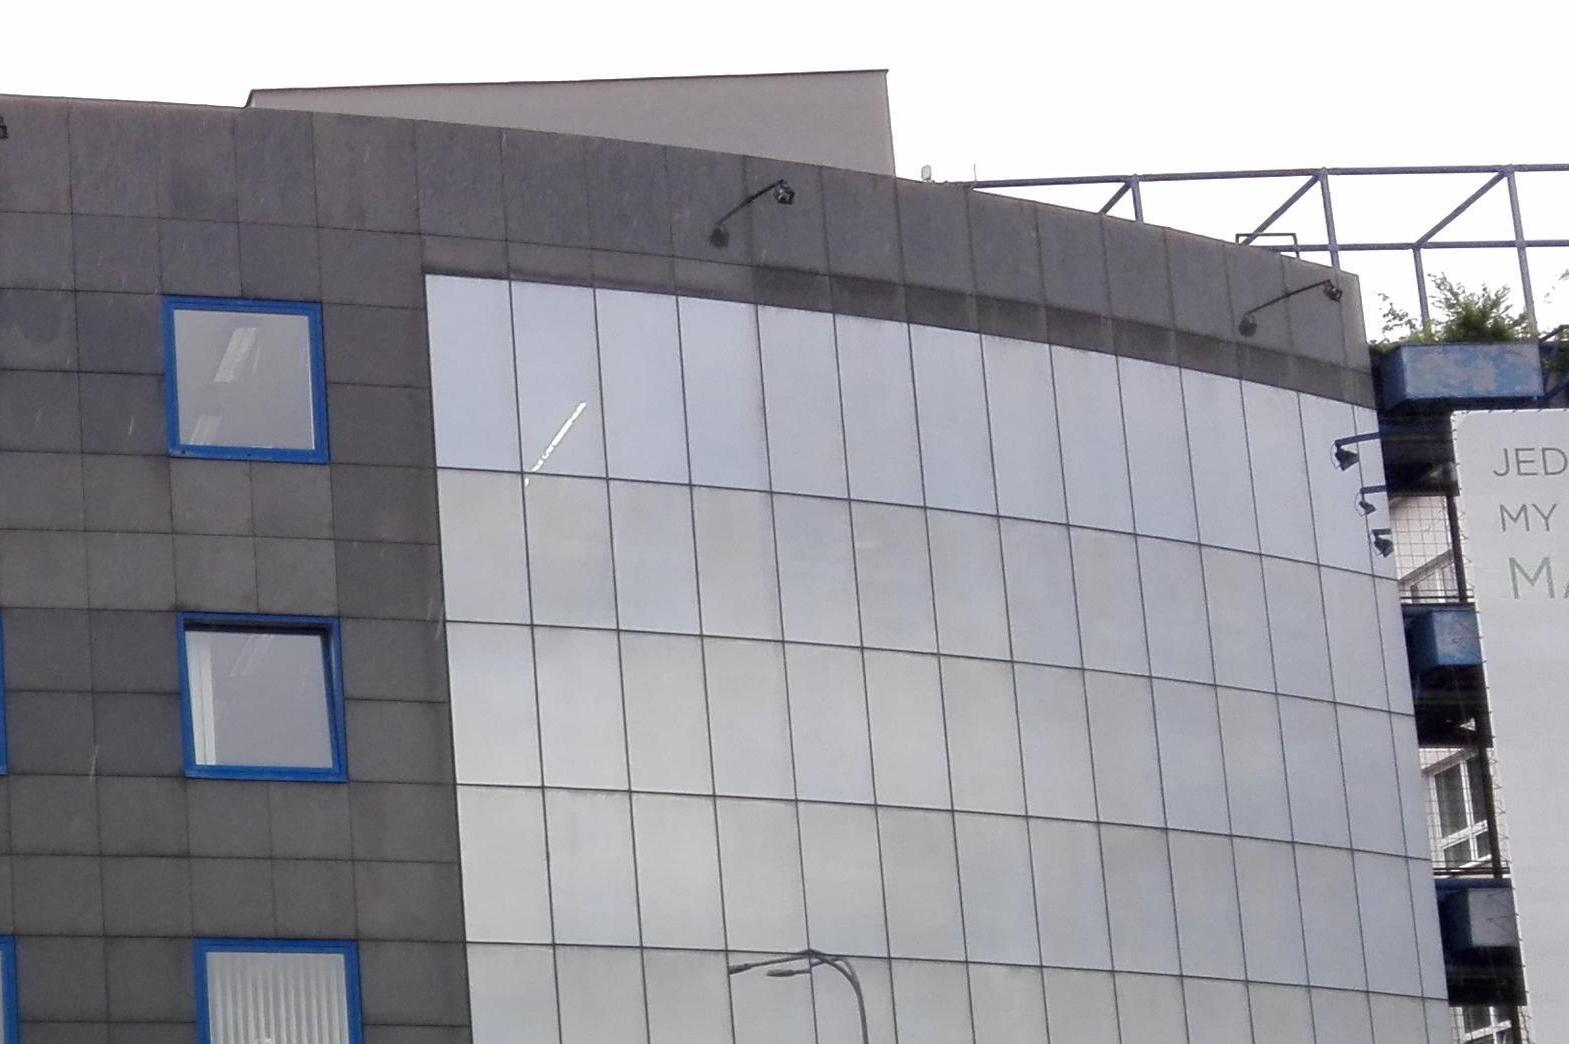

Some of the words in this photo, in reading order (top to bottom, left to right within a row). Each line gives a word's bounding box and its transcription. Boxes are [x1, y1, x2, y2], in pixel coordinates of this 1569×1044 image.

[1493, 448, 1569, 477] JED
[1500, 503, 1557, 533] MY
[1509, 556, 1569, 600] M
